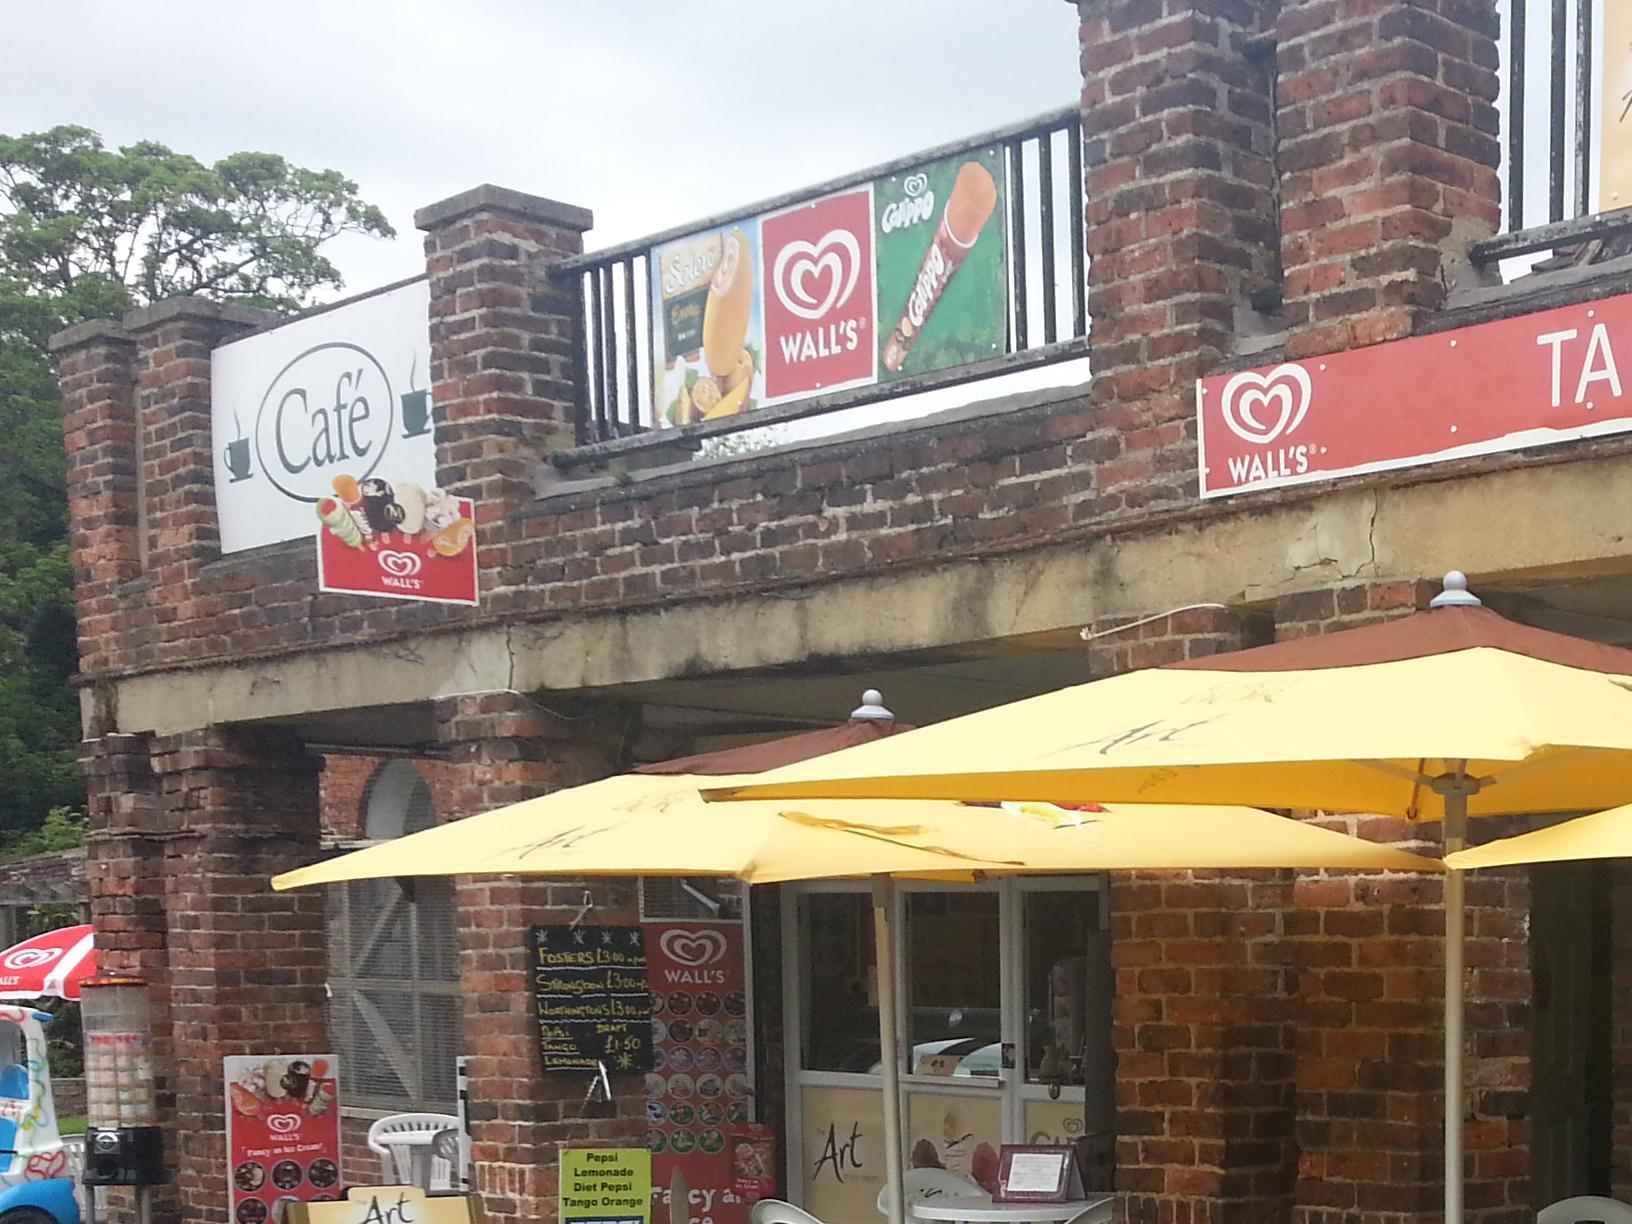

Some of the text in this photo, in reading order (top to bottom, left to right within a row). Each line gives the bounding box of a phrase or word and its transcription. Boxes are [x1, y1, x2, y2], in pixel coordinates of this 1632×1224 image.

[779, 318, 860, 367] WALL'S
[273, 368, 374, 475] Café
[1227, 445, 1309, 485] WALL'S
[381, 575, 421, 590] WALL'S
[538, 946, 595, 965] FOSTERS
[664, 969, 726, 985] WALL'S
[586, 1152, 619, 1164] Pepsi
[812, 1120, 863, 1184] Art
[573, 1167, 634, 1178] Lemonade
[573, 1181, 633, 1193] Diet Pepsi
[562, 1196, 643, 1208] Tango Orange
[651, 1186, 717, 1212] Facy
